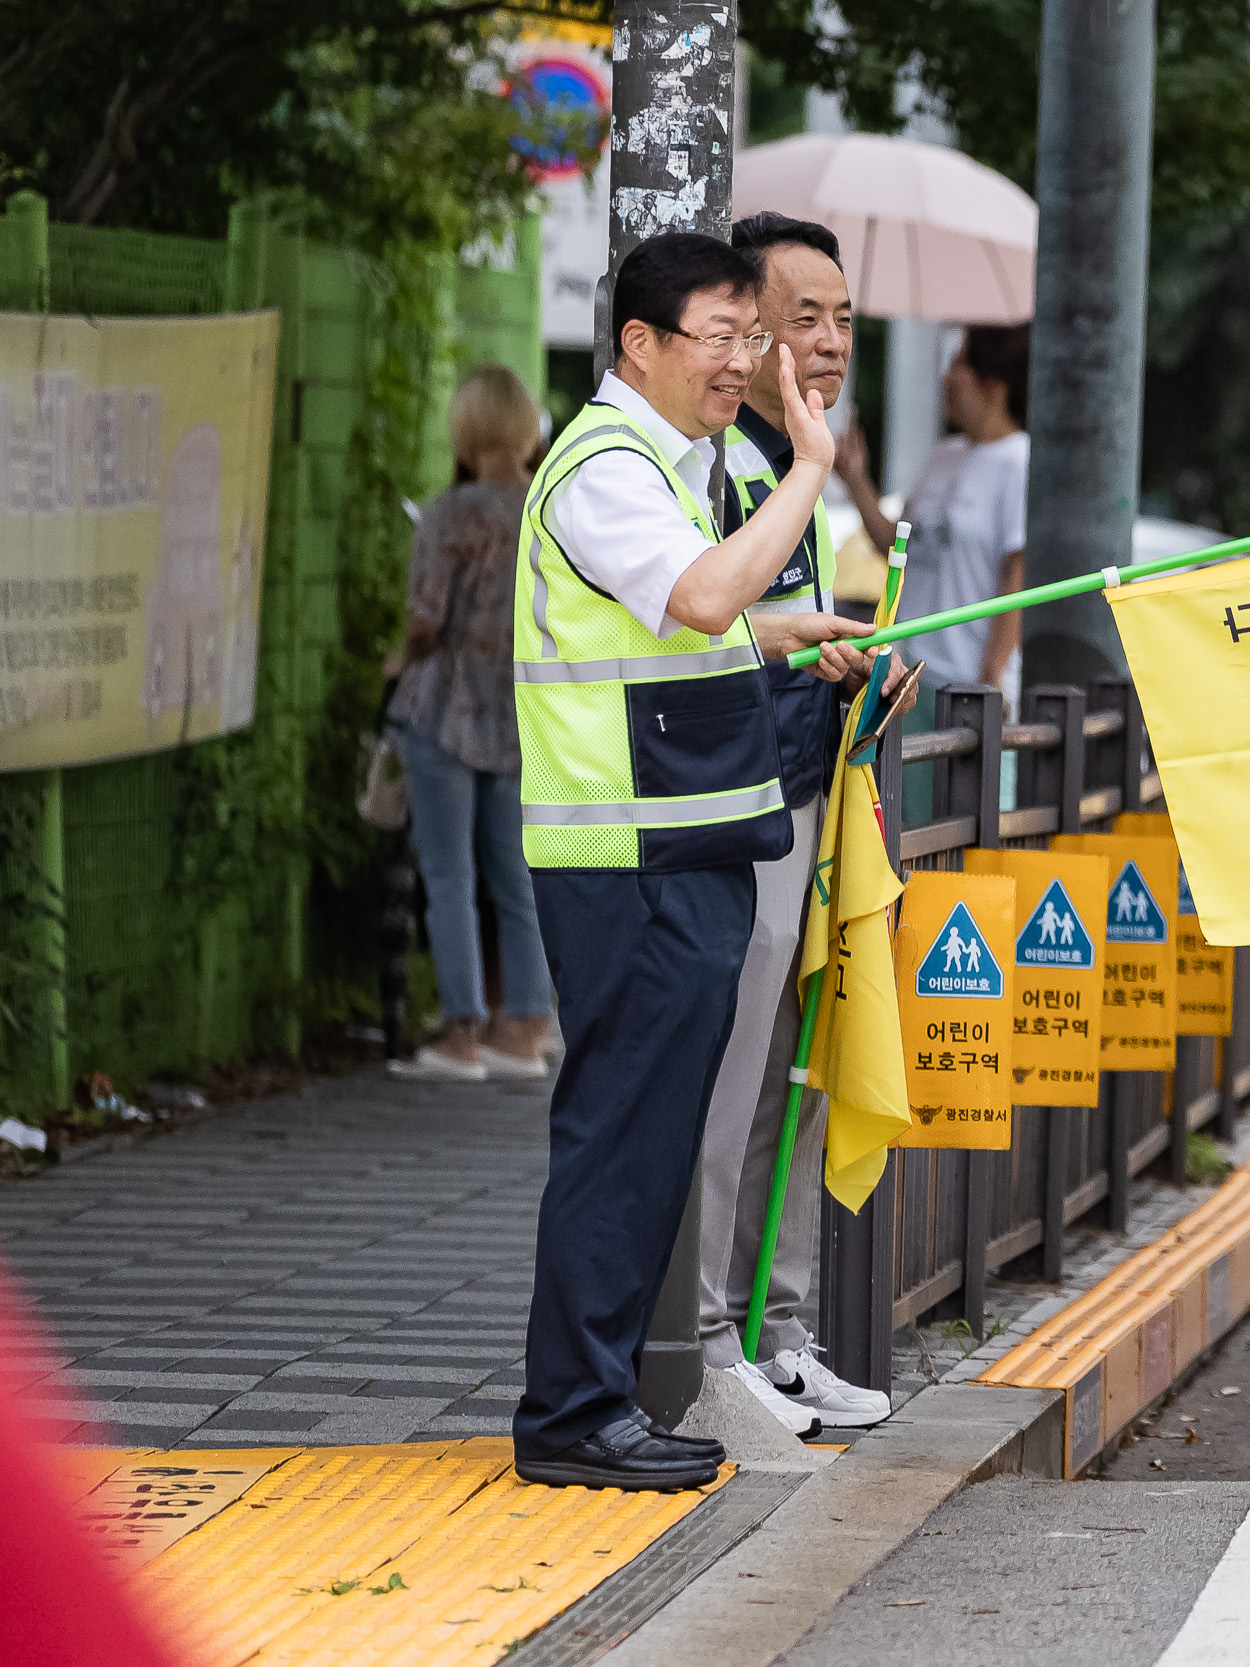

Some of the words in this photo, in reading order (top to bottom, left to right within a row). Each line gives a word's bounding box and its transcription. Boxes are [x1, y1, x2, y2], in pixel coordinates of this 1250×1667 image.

[929, 977, 991, 992] 어린이보호
[1022, 988, 1080, 1010] 어린이
[927, 1021, 989, 1043] 어린이
[1013, 1016, 1089, 1039] 보호구역
[915, 1052, 999, 1074] 보호구역
[945, 1108, 1007, 1122] 광진경찰서
